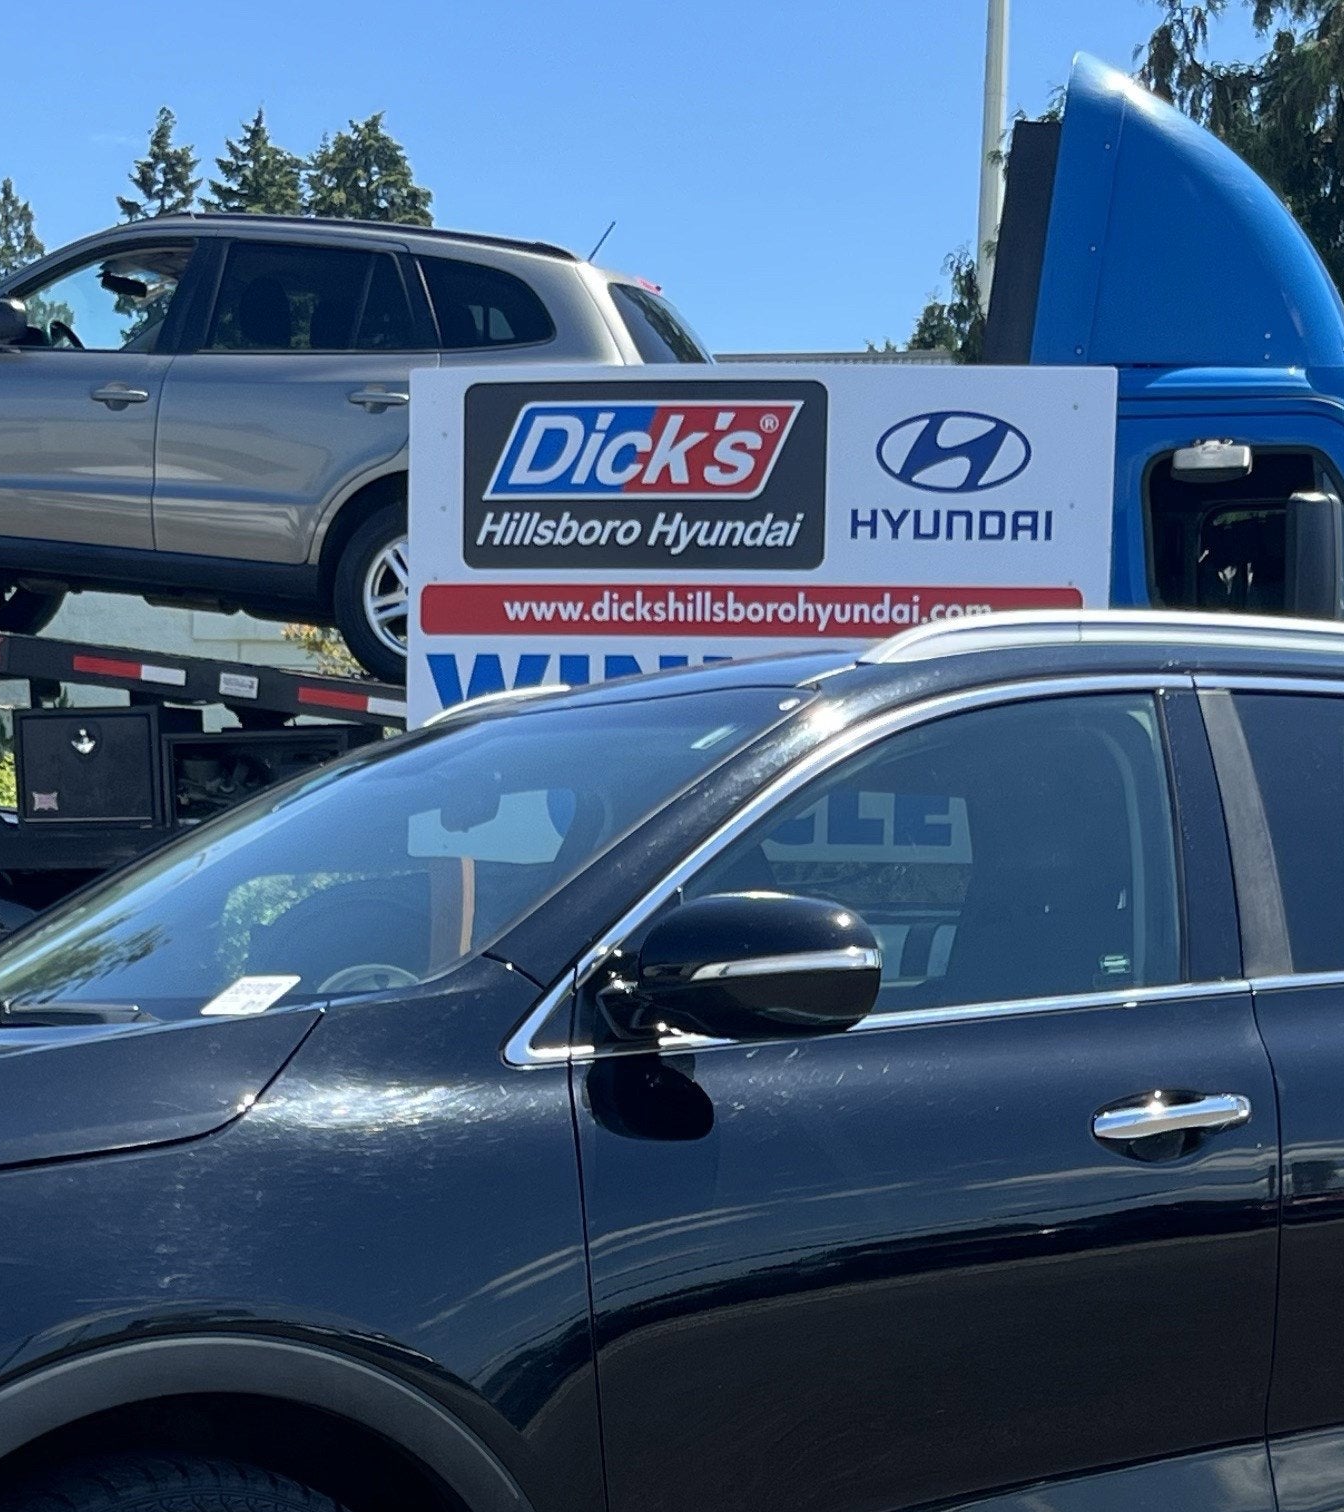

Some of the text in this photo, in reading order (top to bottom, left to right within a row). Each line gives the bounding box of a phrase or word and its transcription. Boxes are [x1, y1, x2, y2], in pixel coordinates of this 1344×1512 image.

[476, 512, 805, 555] Hillsboro Hyundai
[850, 508, 1052, 541] HYUNDAI
